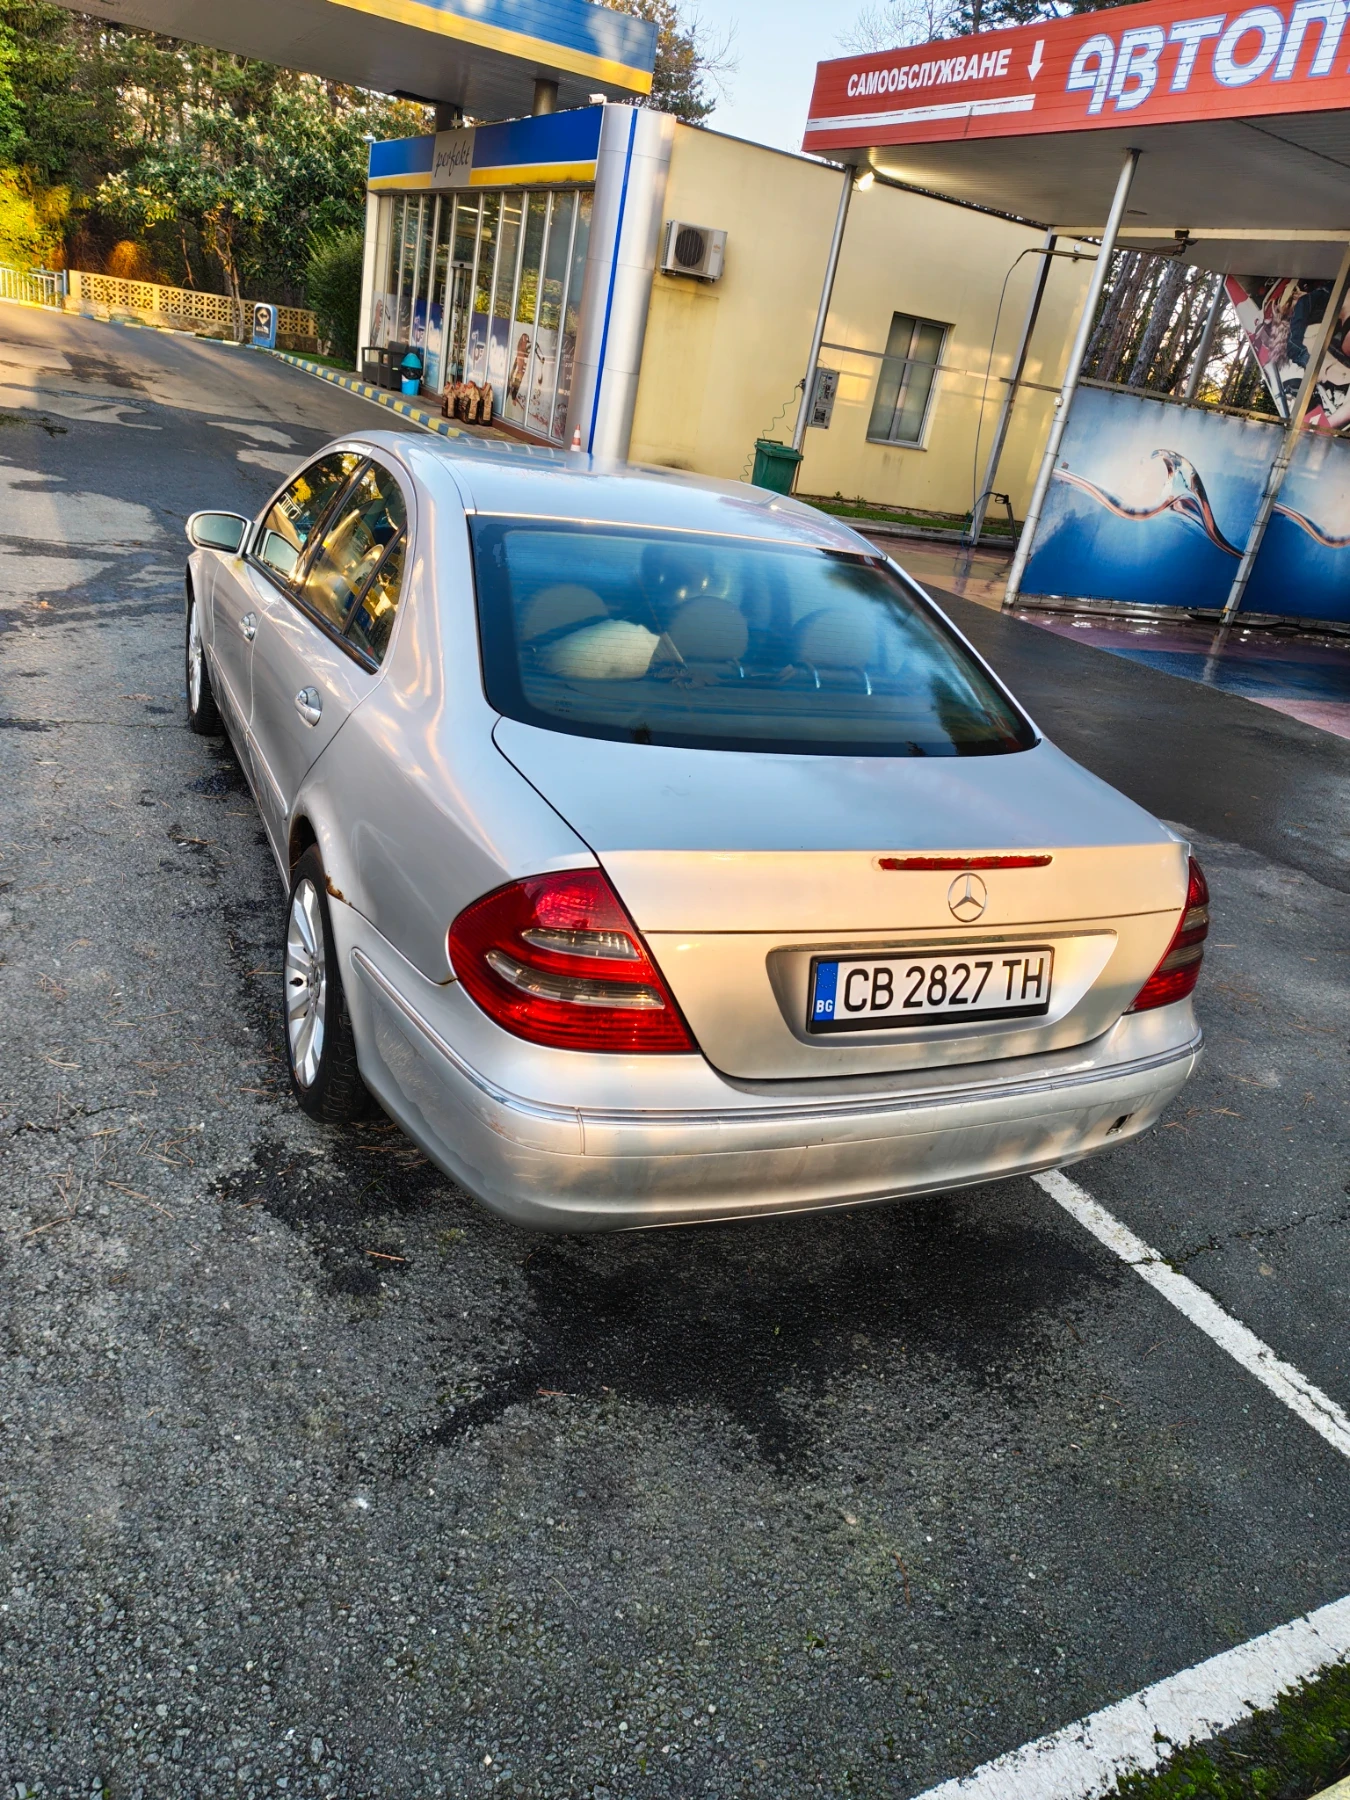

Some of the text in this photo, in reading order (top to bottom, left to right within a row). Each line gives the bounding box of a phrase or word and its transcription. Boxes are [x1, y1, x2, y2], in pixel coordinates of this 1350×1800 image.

[847, 48, 1012, 97] САМООБСЛУЖВАНЕ
[1065, 0, 1350, 115] АВТОП
[434, 140, 471, 178] perfekt
[816, 999, 833, 1014] BG
[843, 957, 1045, 1012] CB 2827 TH
